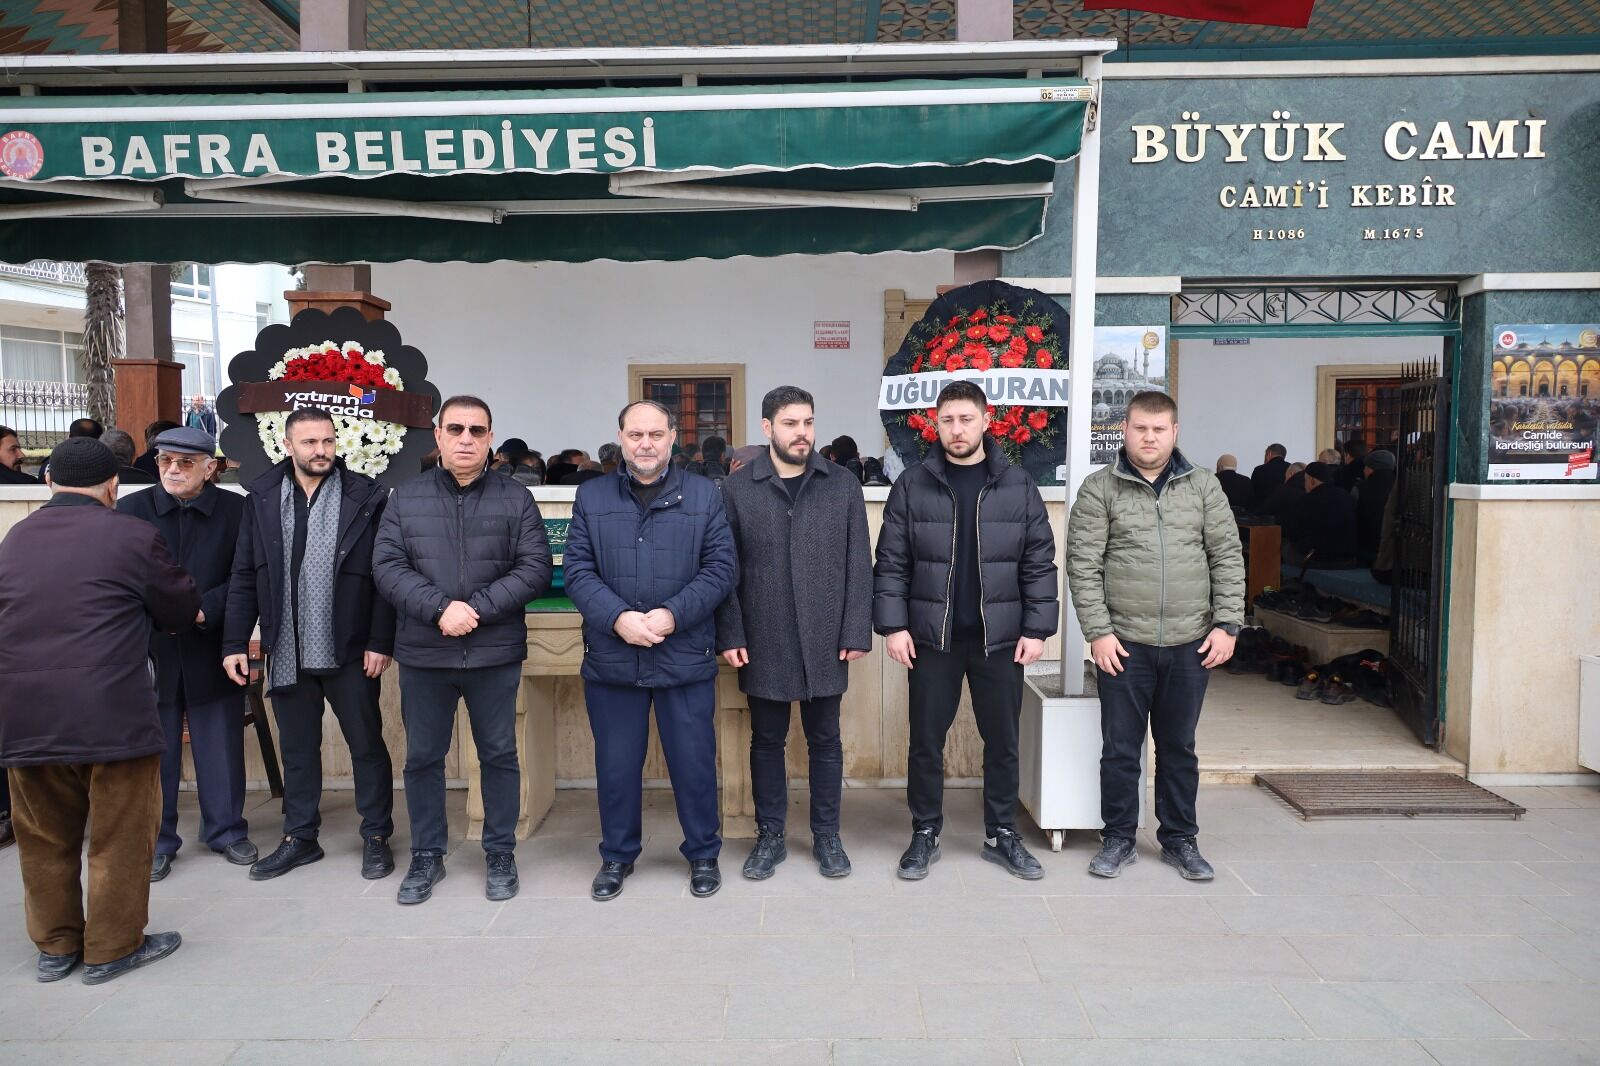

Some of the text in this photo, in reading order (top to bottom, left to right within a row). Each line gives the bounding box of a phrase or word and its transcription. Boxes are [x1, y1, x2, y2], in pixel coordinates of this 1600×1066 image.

[81, 117, 656, 176] BAFRA BELEDİYESİ
[1131, 110, 1347, 163] BÜYÜK
[1351, 175, 1456, 207] KEBÎR
[284, 391, 360, 405] yatırım
[1495, 440, 1593, 451] kardeşliği bulursun!
[1523, 430, 1563, 440] Camide
